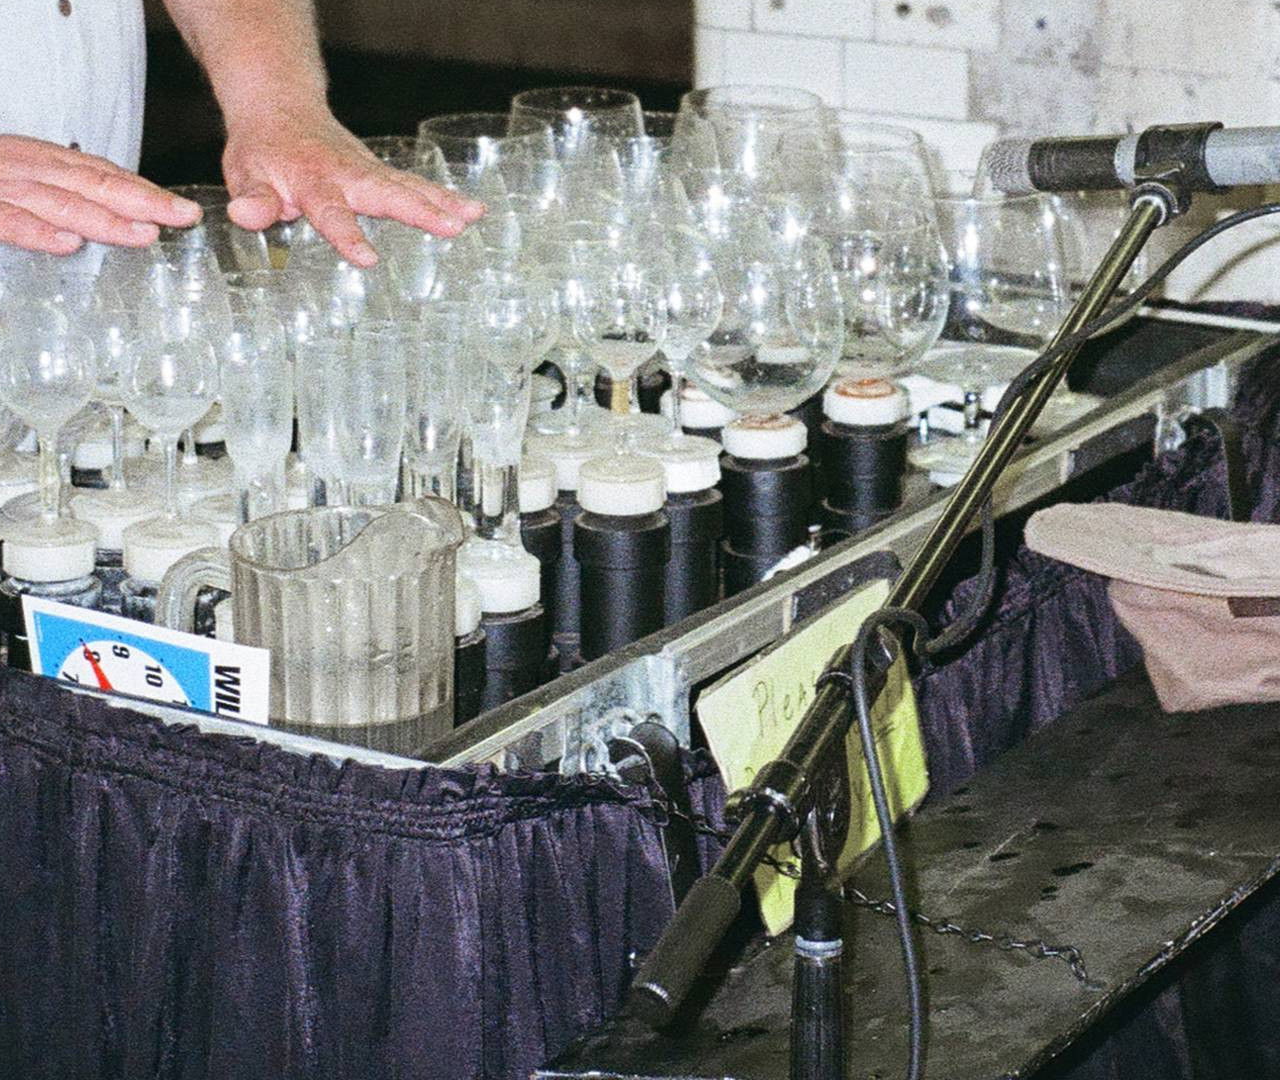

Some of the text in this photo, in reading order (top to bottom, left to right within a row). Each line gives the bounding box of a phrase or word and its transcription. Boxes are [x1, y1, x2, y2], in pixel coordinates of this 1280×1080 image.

[112, 644, 130, 659] 9
[145, 664, 163, 687] 10
[214, 665, 241, 714] WIL
[751, 670, 819, 738] Plea
